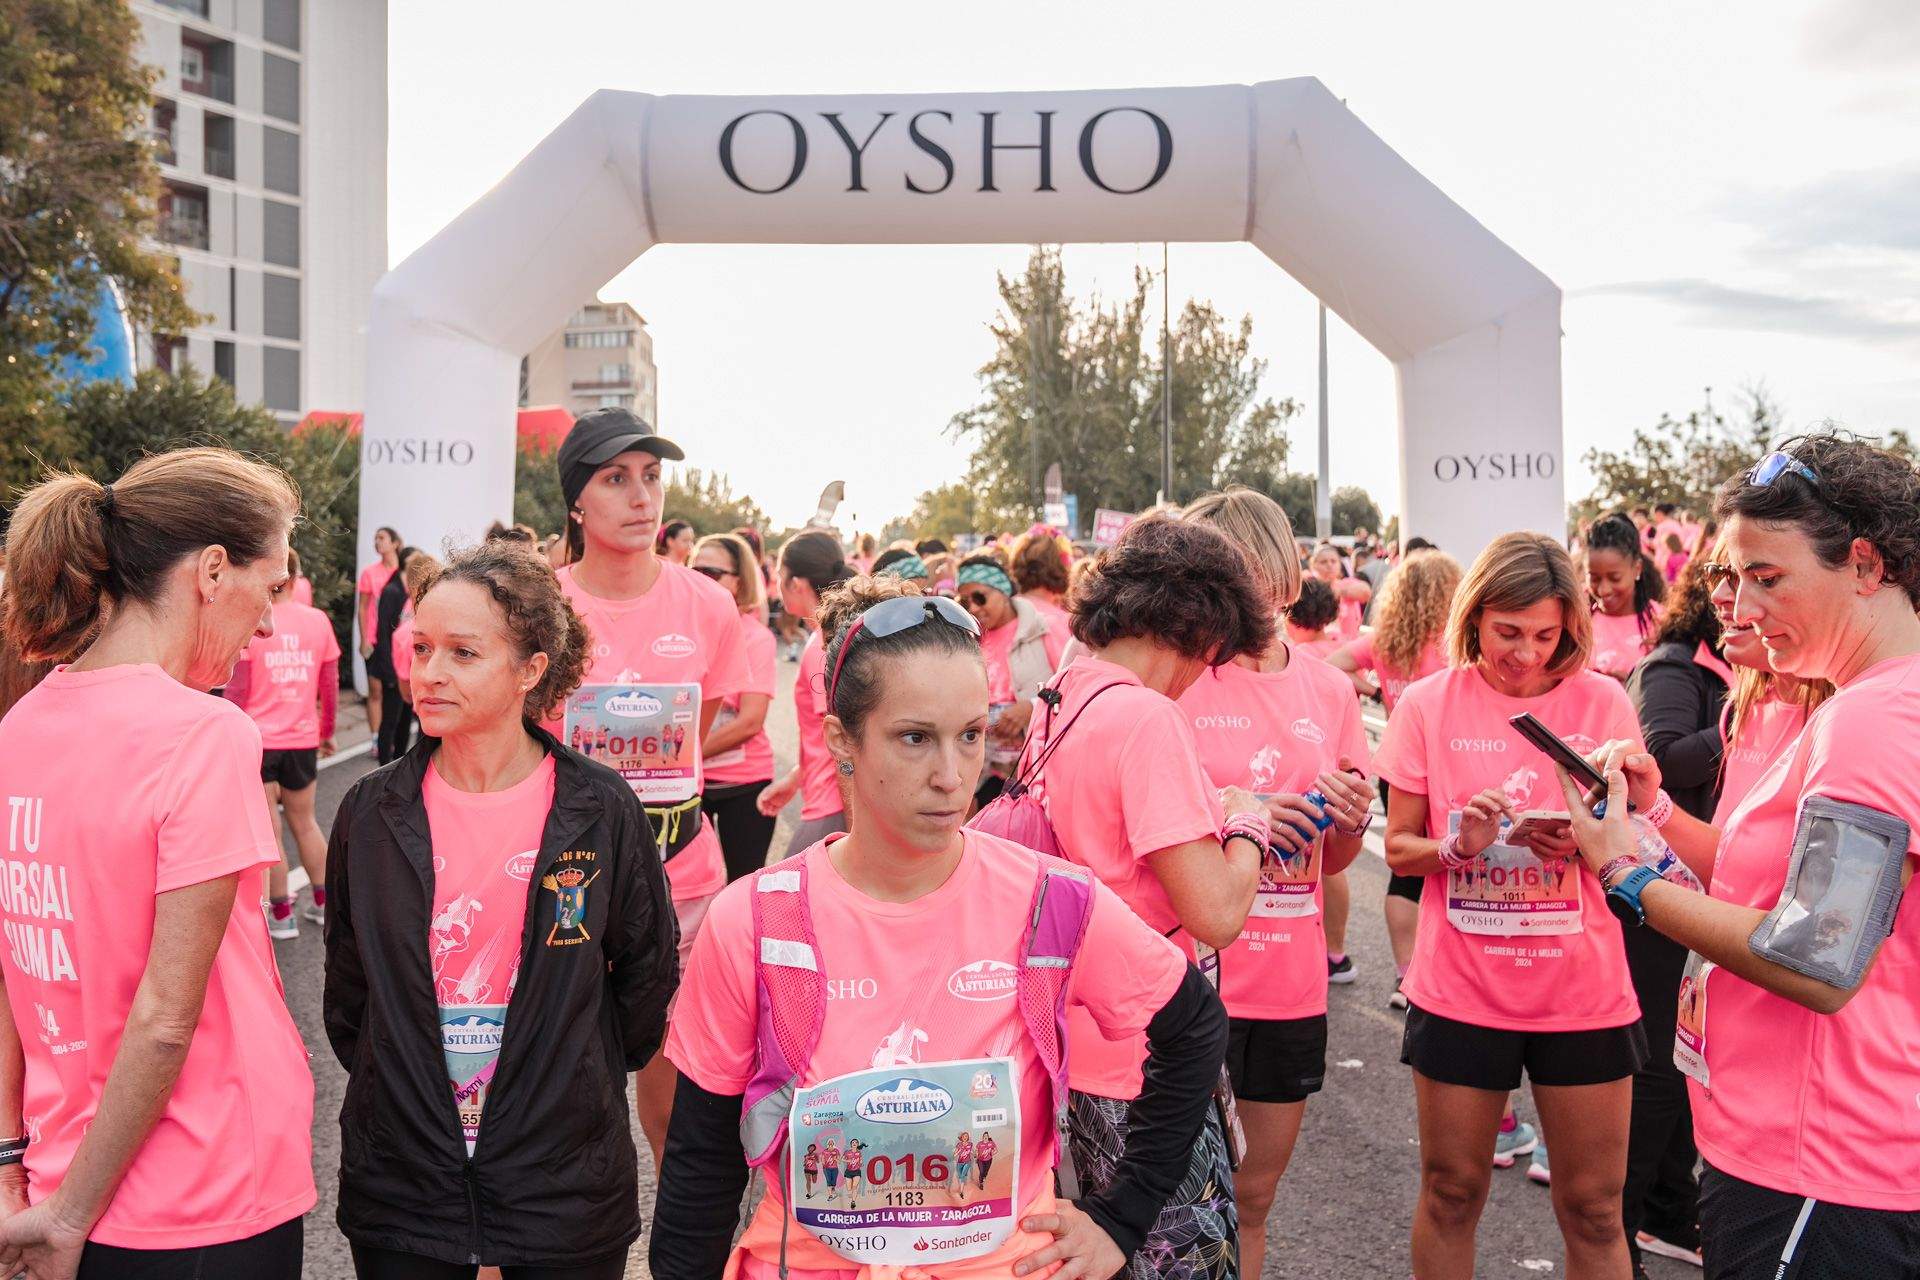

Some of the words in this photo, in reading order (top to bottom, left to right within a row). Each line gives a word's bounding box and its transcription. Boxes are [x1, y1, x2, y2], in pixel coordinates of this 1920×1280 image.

[719, 106, 1173, 194] OYSHO
[367, 438, 474, 466] OYSHO
[1434, 451, 1555, 483] OYSHO
[279, 633, 299, 650] TU
[263, 651, 315, 668] DORSAL
[270, 667, 309, 684] SUMA
[608, 700, 659, 713] ASTURIANA
[1195, 715, 1251, 730] OYSHO
[609, 736, 658, 755] 016
[1450, 738, 1507, 753] OYSHO
[619, 760, 642, 769] 1176
[8, 796, 43, 853] TU
[1490, 866, 1540, 886] 016
[0, 858, 74, 921] ORSAL
[1502, 892, 1527, 901] 1011
[1461, 900, 1489, 910] CARRERA
[1490, 902, 1499, 910] DE
[1500, 903, 1509, 911] LA
[1510, 903, 1532, 911] MUJER
[1535, 902, 1568, 910] ZARAGOZA
[1461, 915, 1504, 927] OYSHO
[1531, 918, 1569, 927] Santander
[4, 920, 80, 983] SUMA
[1248, 941, 1266, 952] 2024
[1484, 945, 1516, 956] CARRERA
[1517, 947, 1527, 957] DE
[1528, 949, 1537, 957] LA
[1538, 948, 1564, 958] MUJER
[1514, 957, 1533, 967] 2024
[827, 978, 878, 1000] SHO
[455, 1076, 484, 1103] Noemi
[975, 1074, 994, 1089] 20
[805, 1093, 841, 1108] SUMA
[863, 1098, 947, 1117] ASTURIANA
[813, 1111, 844, 1120] Zaragoza
[866, 1152, 949, 1185] 016
[885, 1191, 924, 1206] 1183
[817, 1211, 863, 1225] CARRERA
[866, 1213, 879, 1223] DE
[882, 1211, 895, 1222] LA
[897, 1210, 932, 1222] MUJER
[941, 1203, 992, 1222] ZARAGOZA
[819, 1234, 887, 1251] OYSHO
[931, 1231, 993, 1250] Santander
